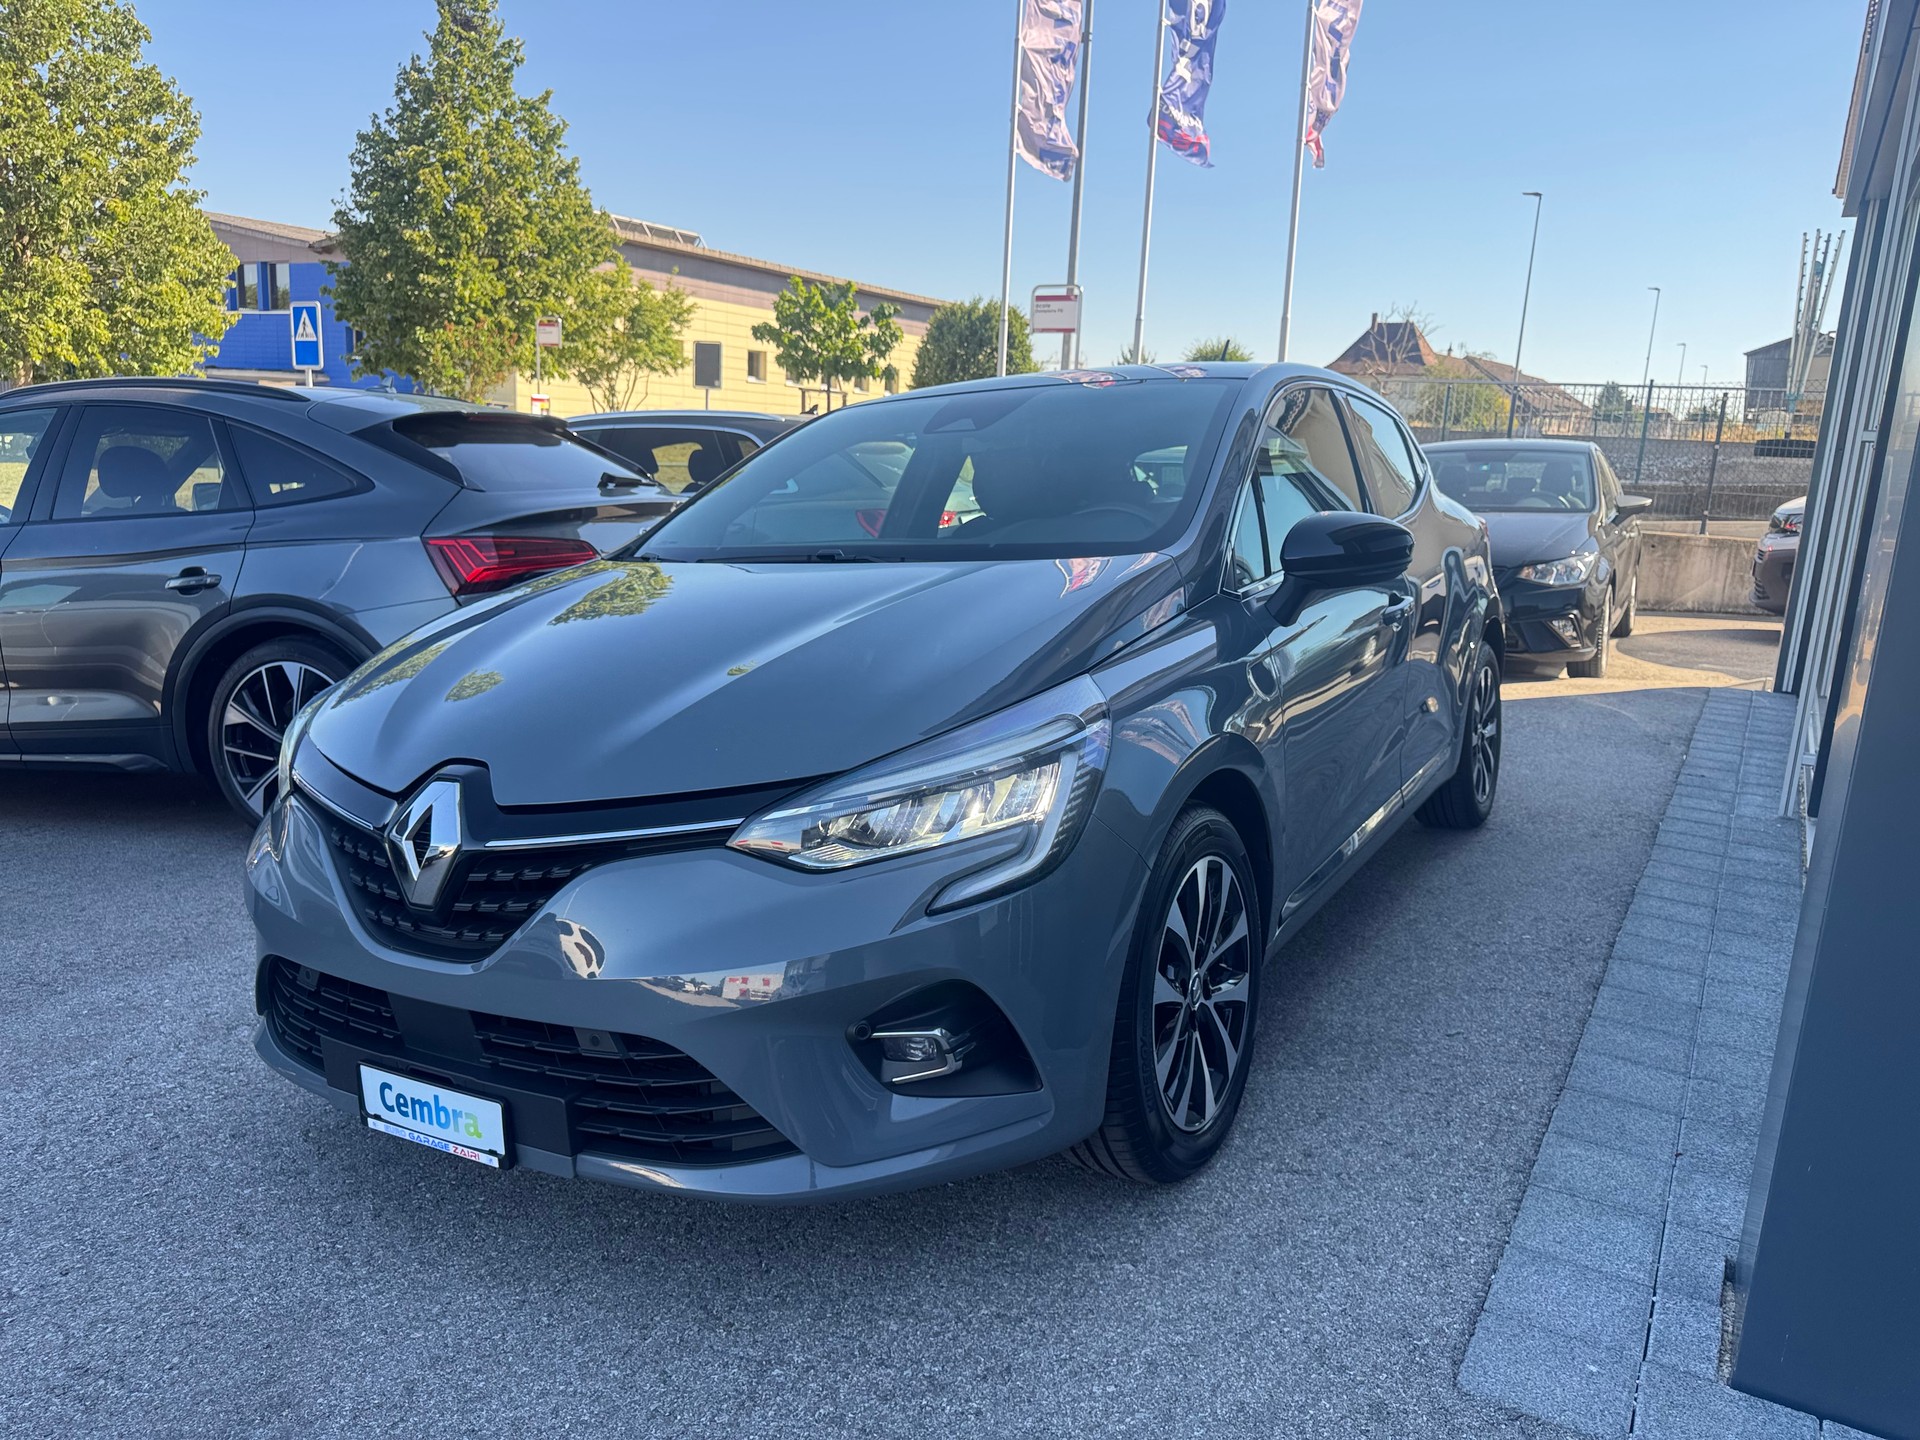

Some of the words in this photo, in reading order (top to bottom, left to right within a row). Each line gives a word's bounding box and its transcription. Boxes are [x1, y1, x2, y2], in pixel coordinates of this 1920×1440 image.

[380, 1082, 483, 1139] Cembra
[408, 1132, 450, 1150] GARAGE
[452, 1145, 480, 1161] ZAIRI
